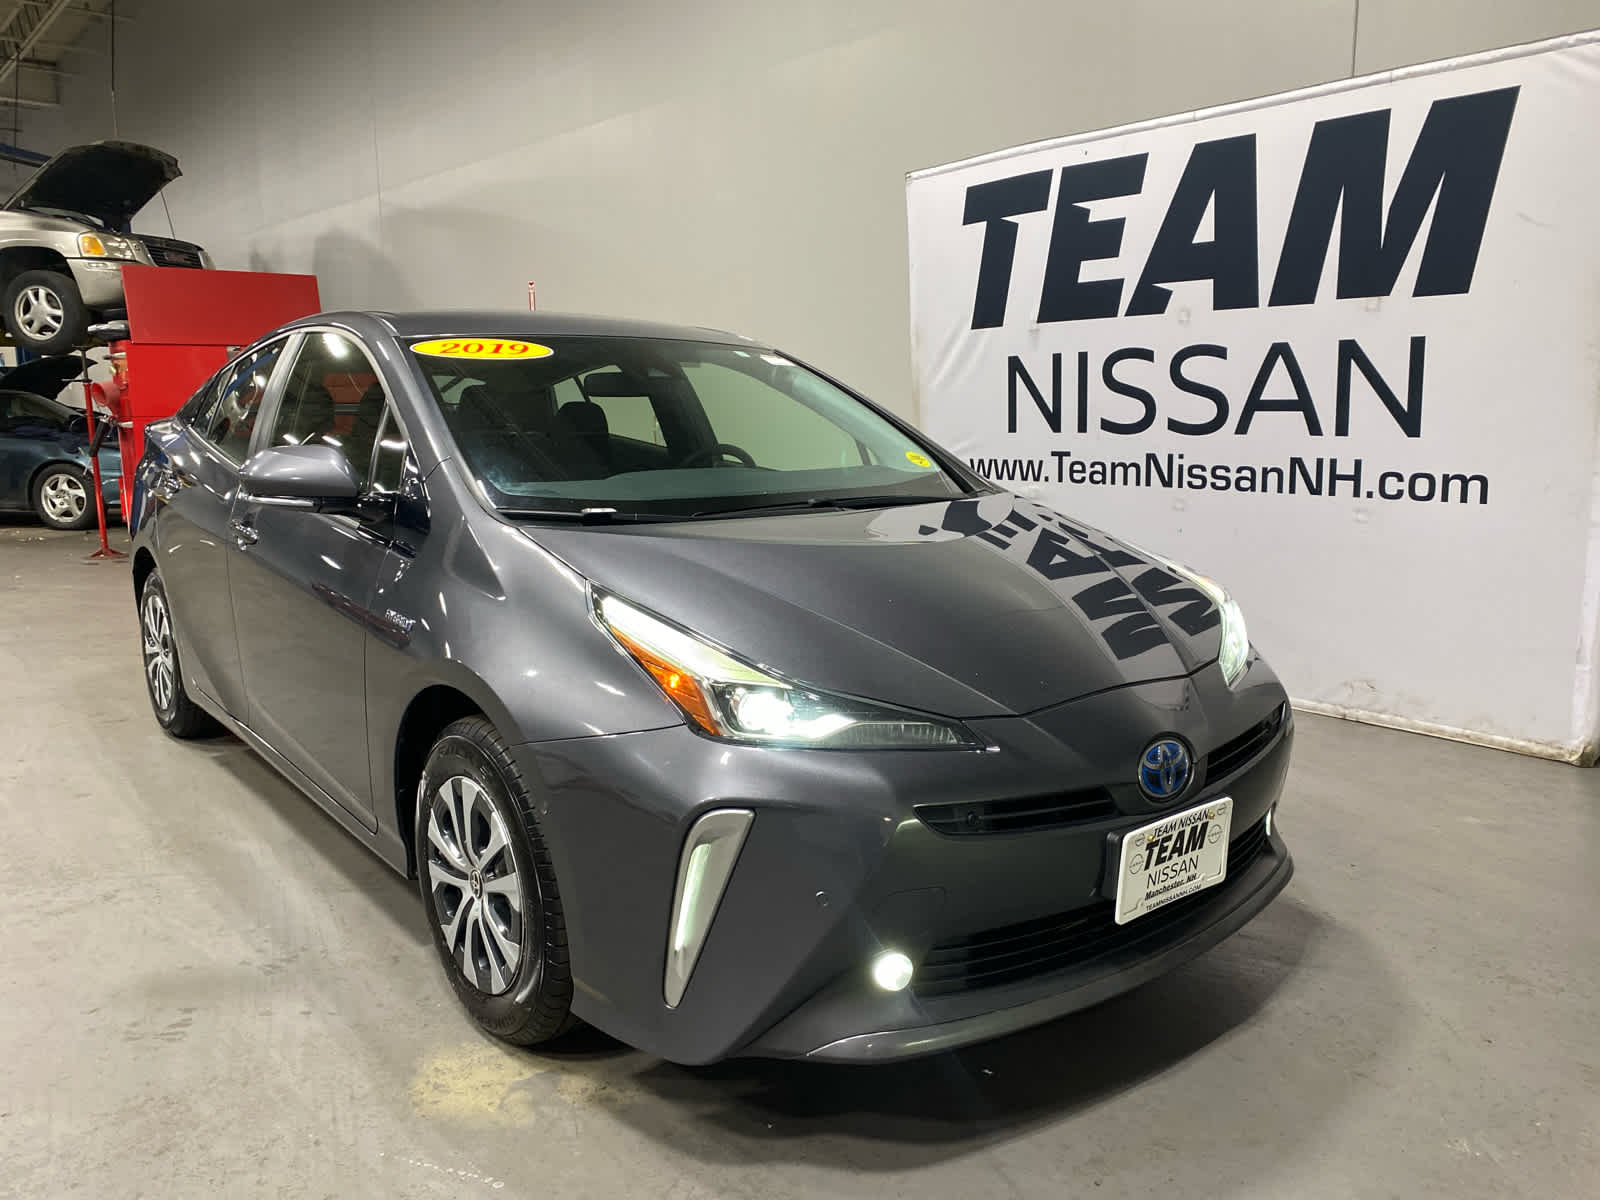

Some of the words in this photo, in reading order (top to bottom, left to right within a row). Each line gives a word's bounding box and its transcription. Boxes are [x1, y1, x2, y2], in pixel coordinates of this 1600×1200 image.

[962, 85, 1521, 329] TEAM
[440, 343, 529, 354] 2019
[1007, 335, 1426, 438] NISSAN
[970, 451, 1489, 505] www.TeamNissanNH.com
[1144, 821, 1209, 871] TEAM
[1153, 822, 1177, 838] TEAM
[1179, 809, 1210, 828] NISSAN
[1146, 856, 1198, 888] NISSAN
